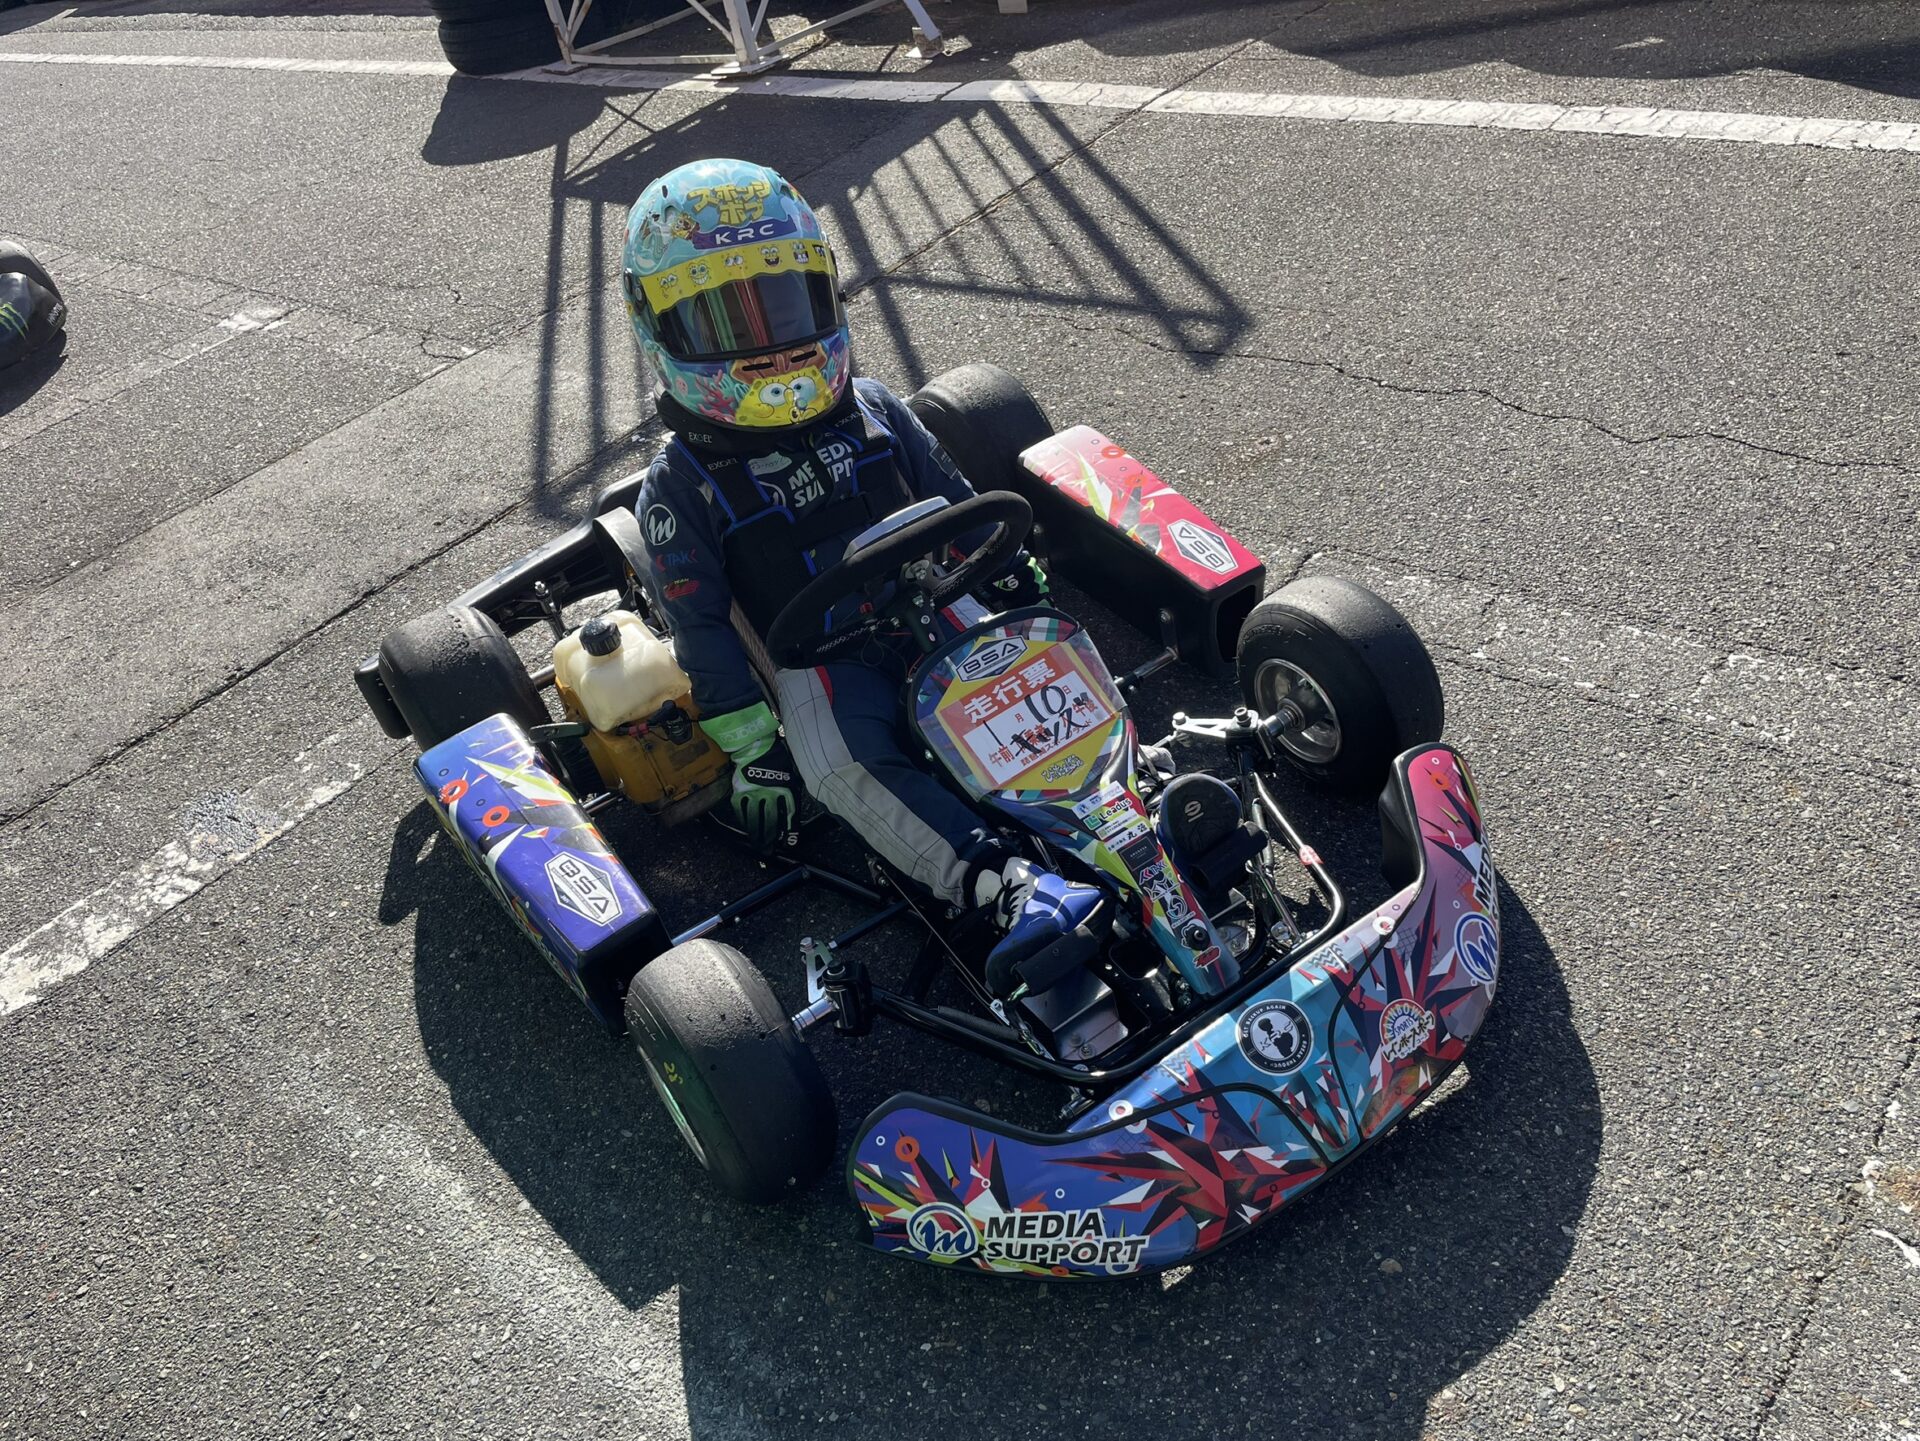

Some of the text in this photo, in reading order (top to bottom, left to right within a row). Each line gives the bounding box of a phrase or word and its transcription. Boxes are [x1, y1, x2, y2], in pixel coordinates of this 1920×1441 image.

[715, 223, 775, 245] KRC
[1179, 525, 1224, 568] BSA
[963, 643, 1019, 673] BSA
[964, 658, 1056, 724] 走行票
[1024, 685, 1067, 724] 10
[720, 717, 766, 743] sparco
[748, 768, 791, 781] sparco
[1100, 798, 1132, 821] Leadus
[558, 860, 610, 914] BSA
[1394, 1017, 1414, 1036] SPORTS
[986, 1211, 1103, 1239] MEDIA
[985, 1238, 1147, 1265] SUPPORT
